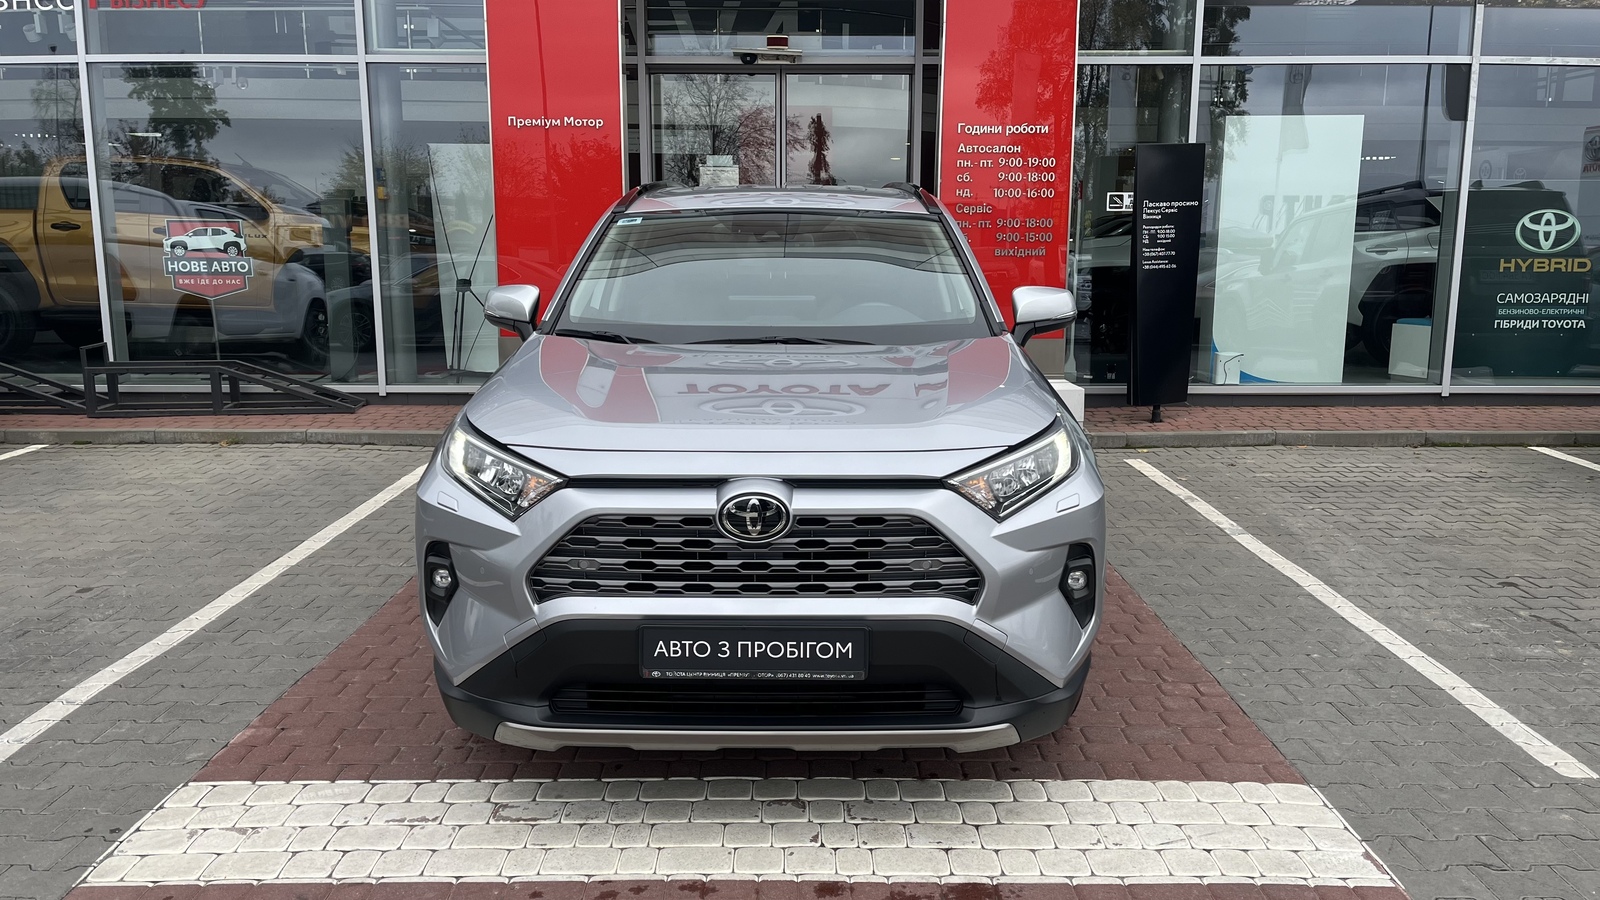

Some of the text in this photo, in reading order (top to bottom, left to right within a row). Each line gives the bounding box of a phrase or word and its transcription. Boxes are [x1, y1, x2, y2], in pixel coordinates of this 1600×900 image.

[507, 116, 604, 129] Преміум Мотор
[957, 123, 1049, 136] Години роботи
[957, 143, 1021, 153] Автосалон
[998, 158, 1056, 167] 9:00-19:00
[956, 172, 1055, 182] сб. 9:00-18:00
[956, 188, 1055, 198] нд. 10:00-16:00
[956, 203, 993, 215] Сервіс
[996, 218, 1053, 228] 9:00-18:00
[996, 233, 1053, 242] 9:00-15:00
[995, 246, 1046, 257] вихідний
[168, 261, 249, 272] НОВЕ АВТО
[1499, 259, 1592, 272] HYBRID
[1496, 293, 1589, 305] САМОЗАРЯДНІ
[1494, 320, 1586, 329] ГІБРИДИ TOYOTA
[654, 640, 711, 657] АВТО
[738, 641, 852, 659] ПРОБІГОМ
